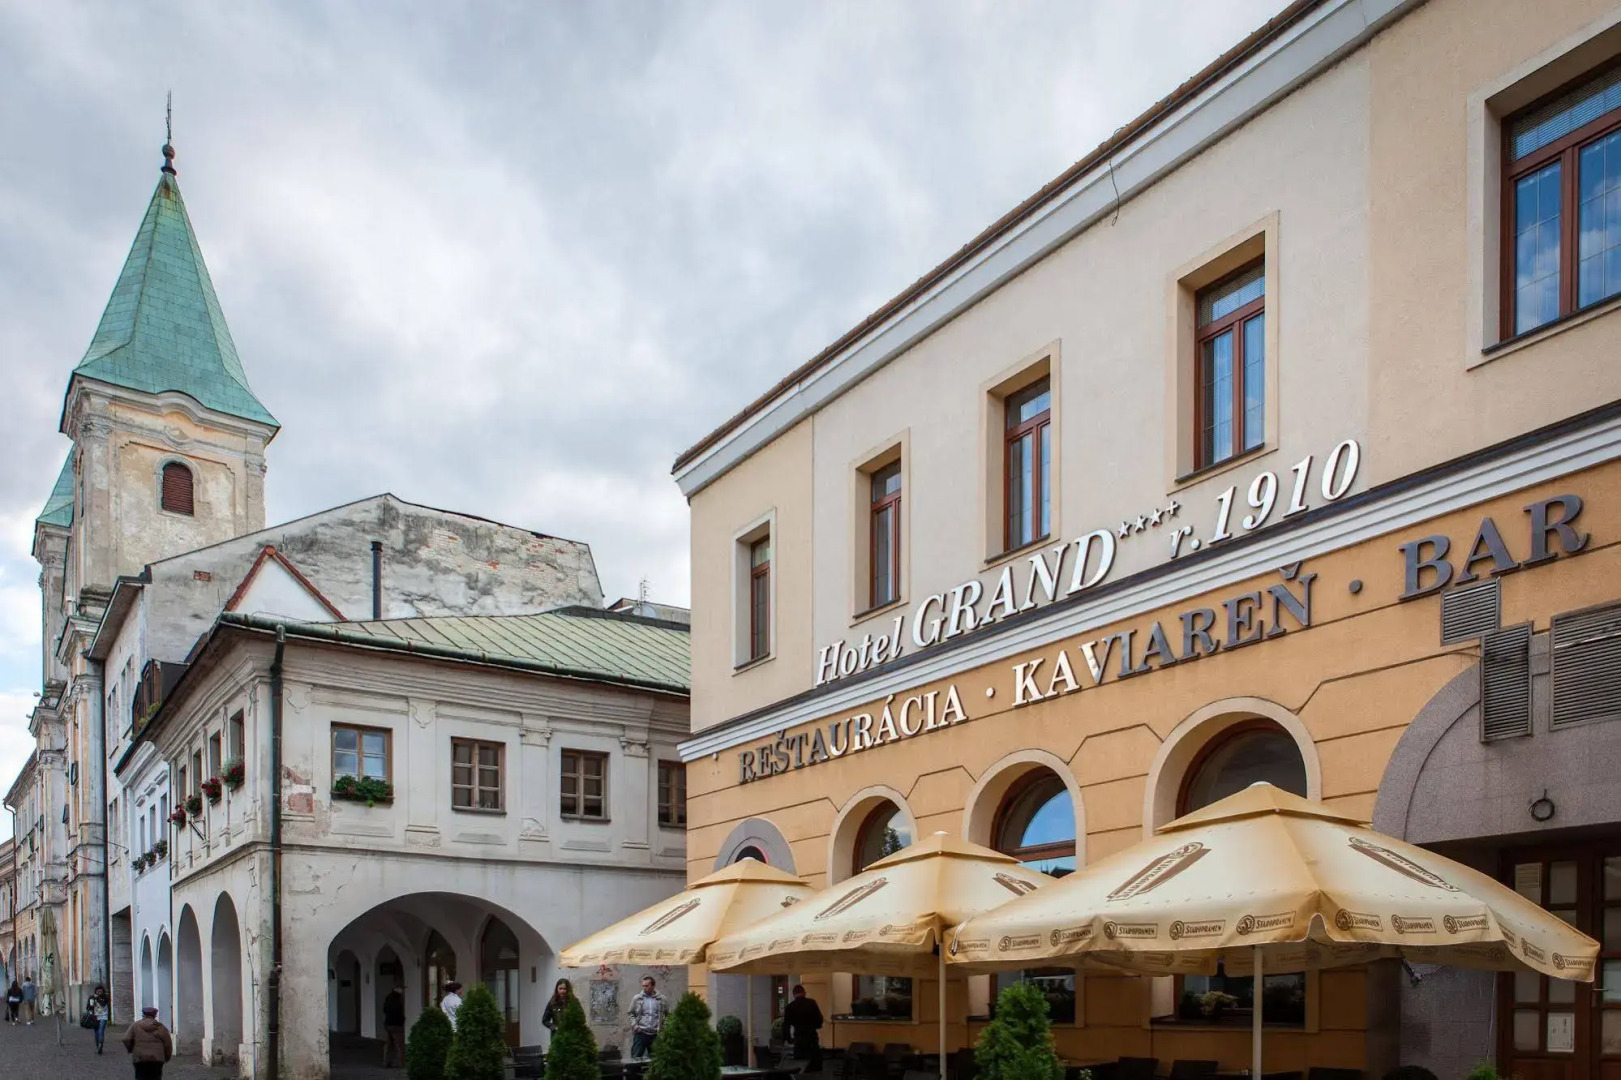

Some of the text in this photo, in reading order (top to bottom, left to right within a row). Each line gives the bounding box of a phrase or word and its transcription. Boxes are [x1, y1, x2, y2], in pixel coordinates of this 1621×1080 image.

[738, 494, 1591, 783] REŠTAURÁCIA KAVIAREŇ BAR
[815, 615, 904, 688] Hotel
[912, 528, 1116, 648] GRAND
